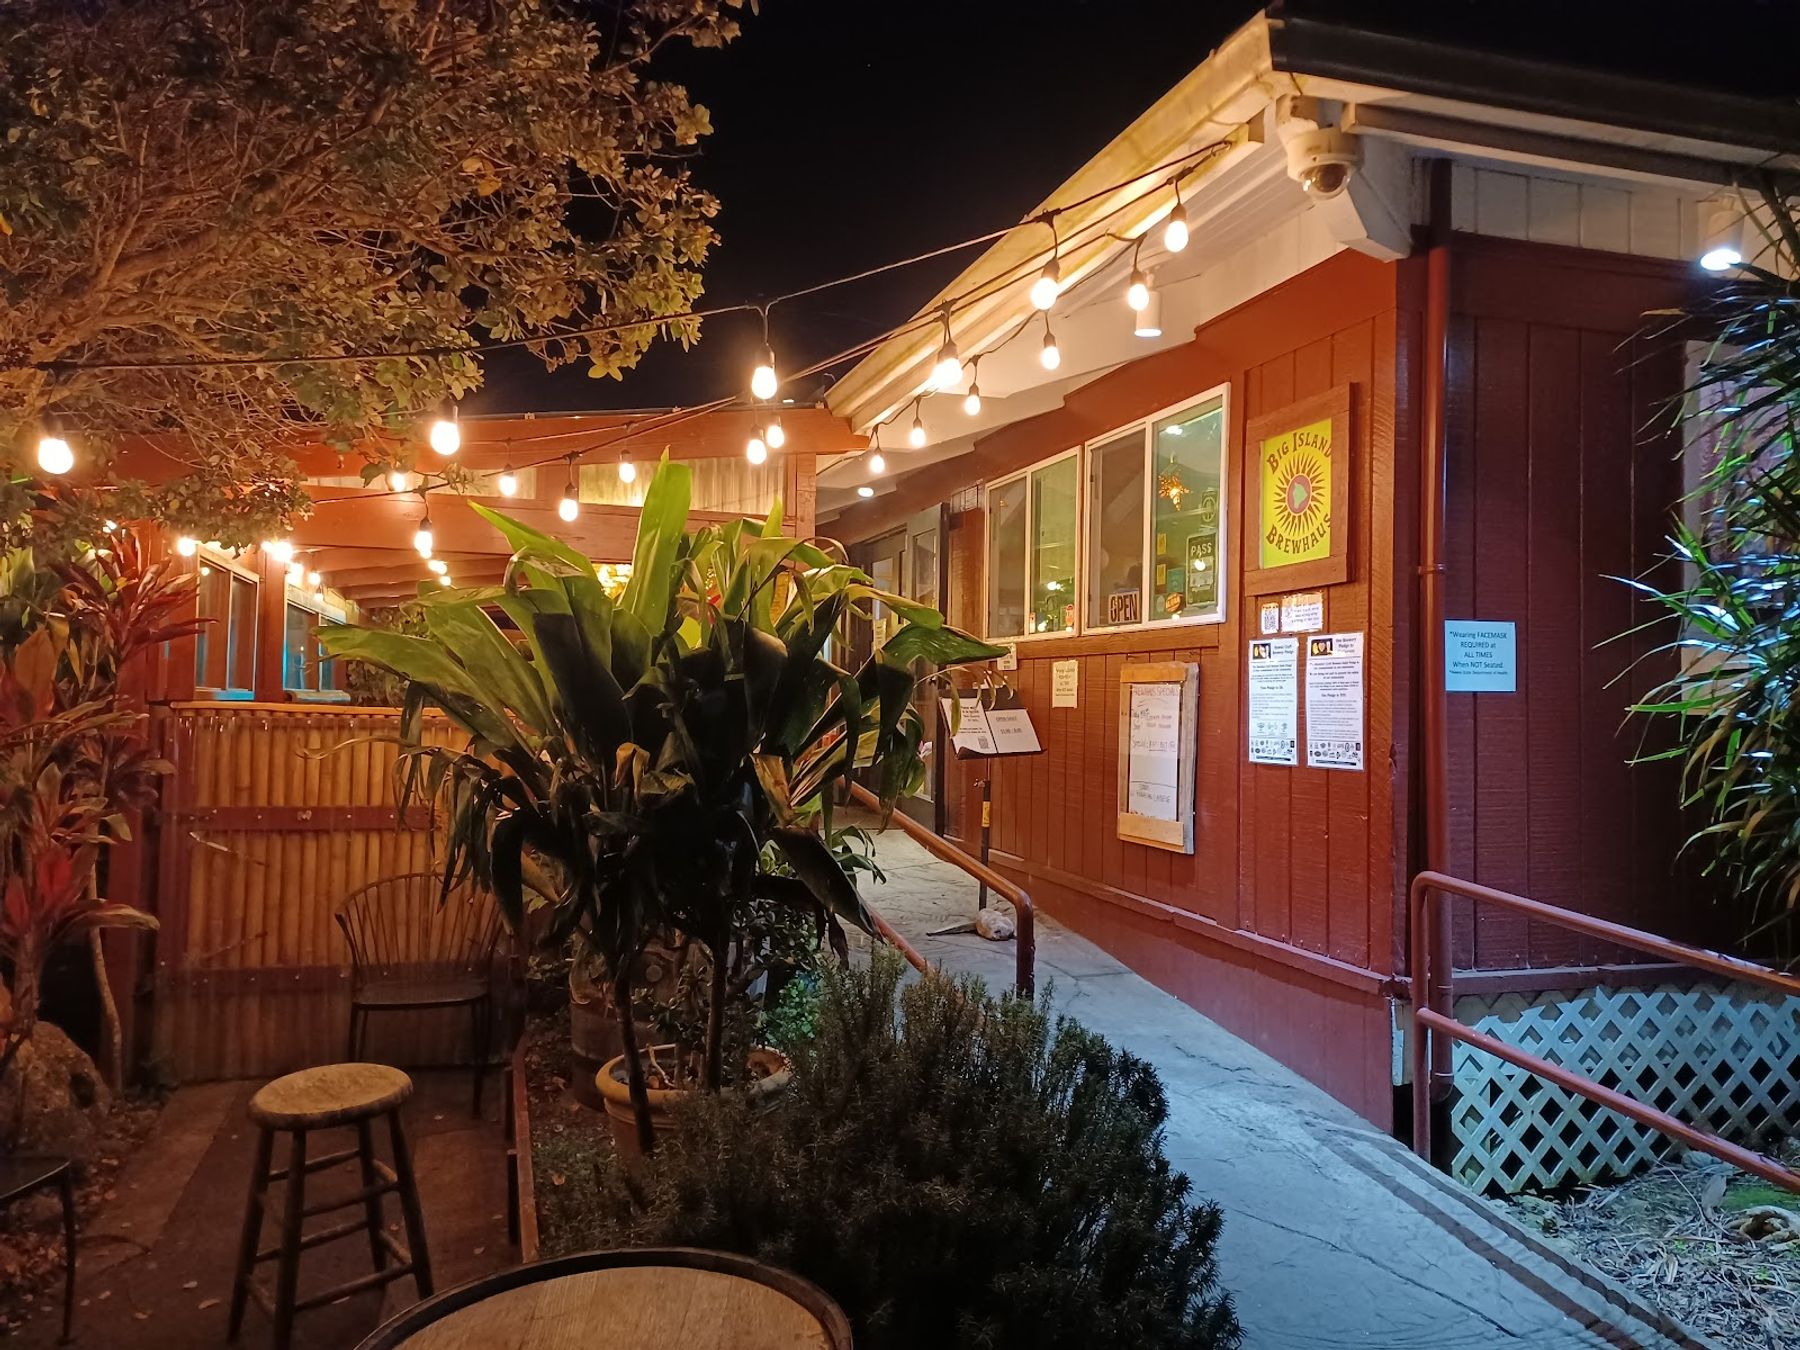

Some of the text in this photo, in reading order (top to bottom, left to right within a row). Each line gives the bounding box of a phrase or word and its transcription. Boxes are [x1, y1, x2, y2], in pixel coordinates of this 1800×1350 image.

[1266, 441, 1289, 474] BIG
[1190, 542, 1213, 557] PASS
[1110, 594, 1138, 622] OPEN
[1477, 631, 1507, 639] FACEMASK
